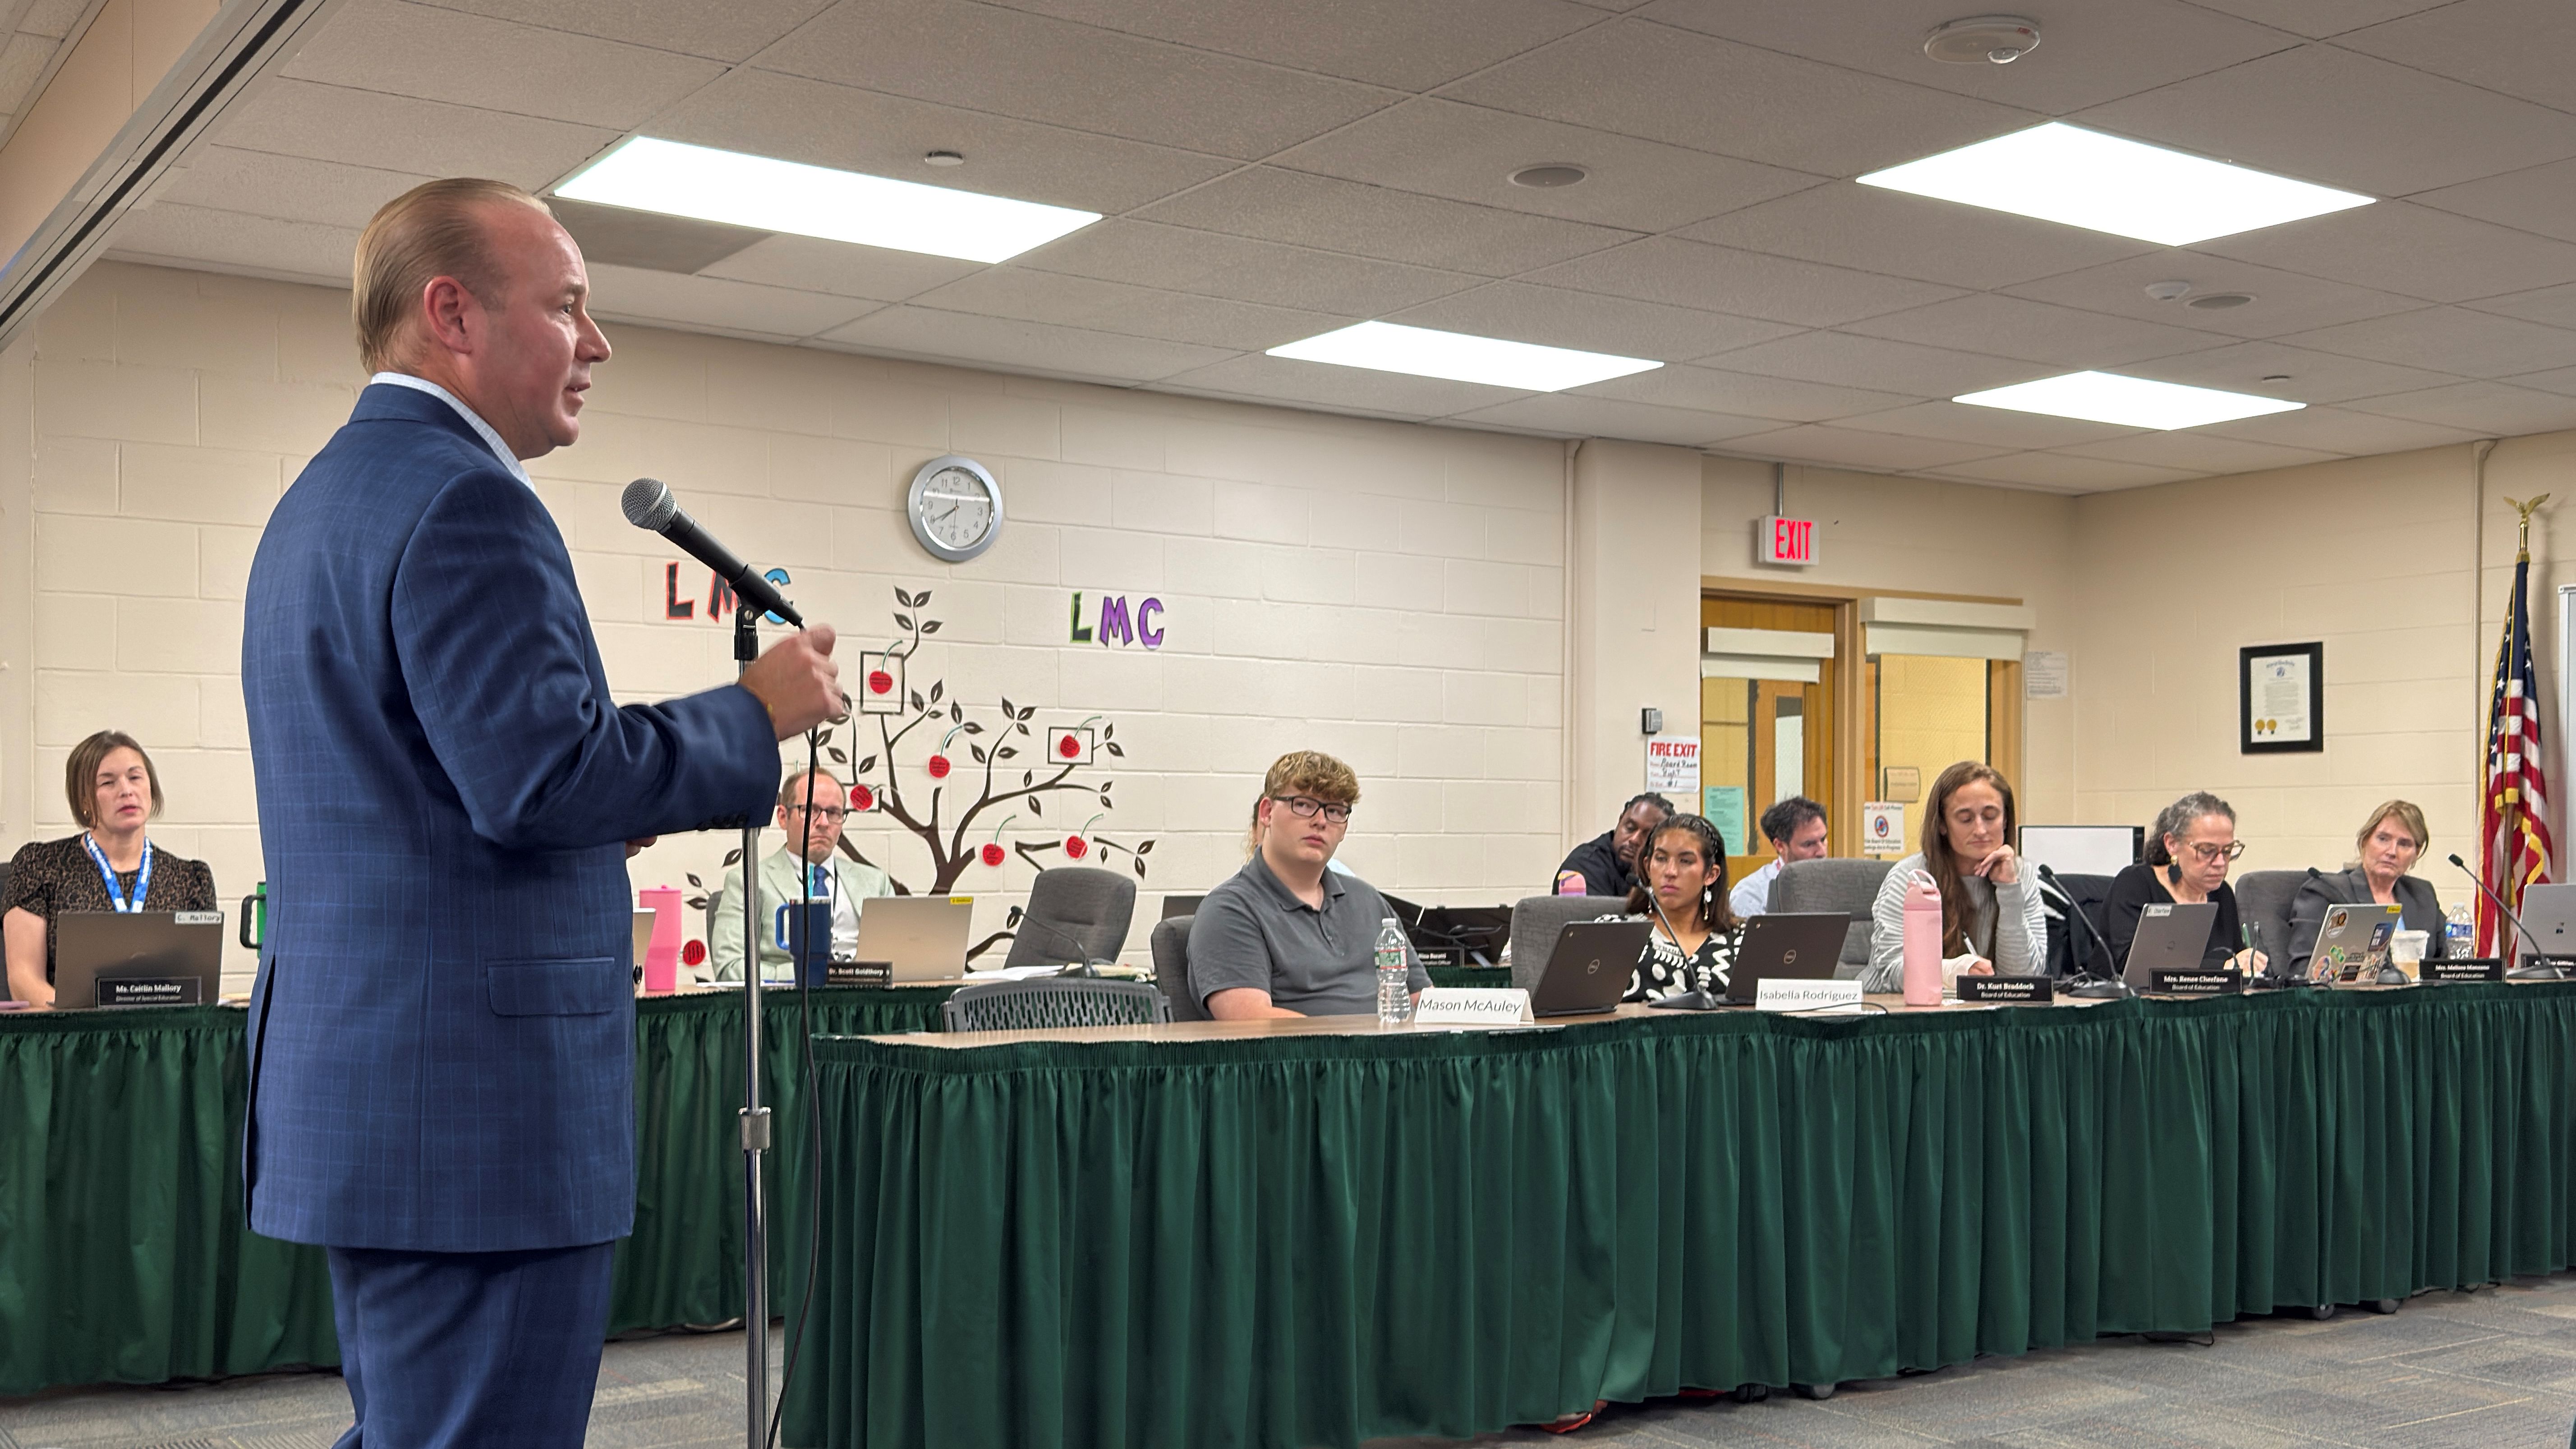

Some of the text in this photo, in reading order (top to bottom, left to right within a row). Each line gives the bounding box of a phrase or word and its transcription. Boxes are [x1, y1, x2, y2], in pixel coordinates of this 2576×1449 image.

[941, 478, 948, 488] 11
[953, 476, 961, 485] 12
[928, 501, 933, 510] 9
[977, 507, 983, 516] 3
[974, 521, 978, 529] 4
[951, 532, 956, 540] 6
[964, 529, 969, 538] 5
[1775, 519, 1812, 561] EXIT
[1070, 590, 1165, 651] LMC
[1650, 742, 1697, 758] FIRE EXIT
[2164, 975, 2178, 983] Mrs.
[116, 984, 182, 994] Ms. Caitlin Mallory
[1977, 982, 2035, 990] Dr. Kurt Braddock
[1760, 990, 1858, 1002] Isabella Rodriguez
[1419, 998, 1522, 1015] Mason McAuley
